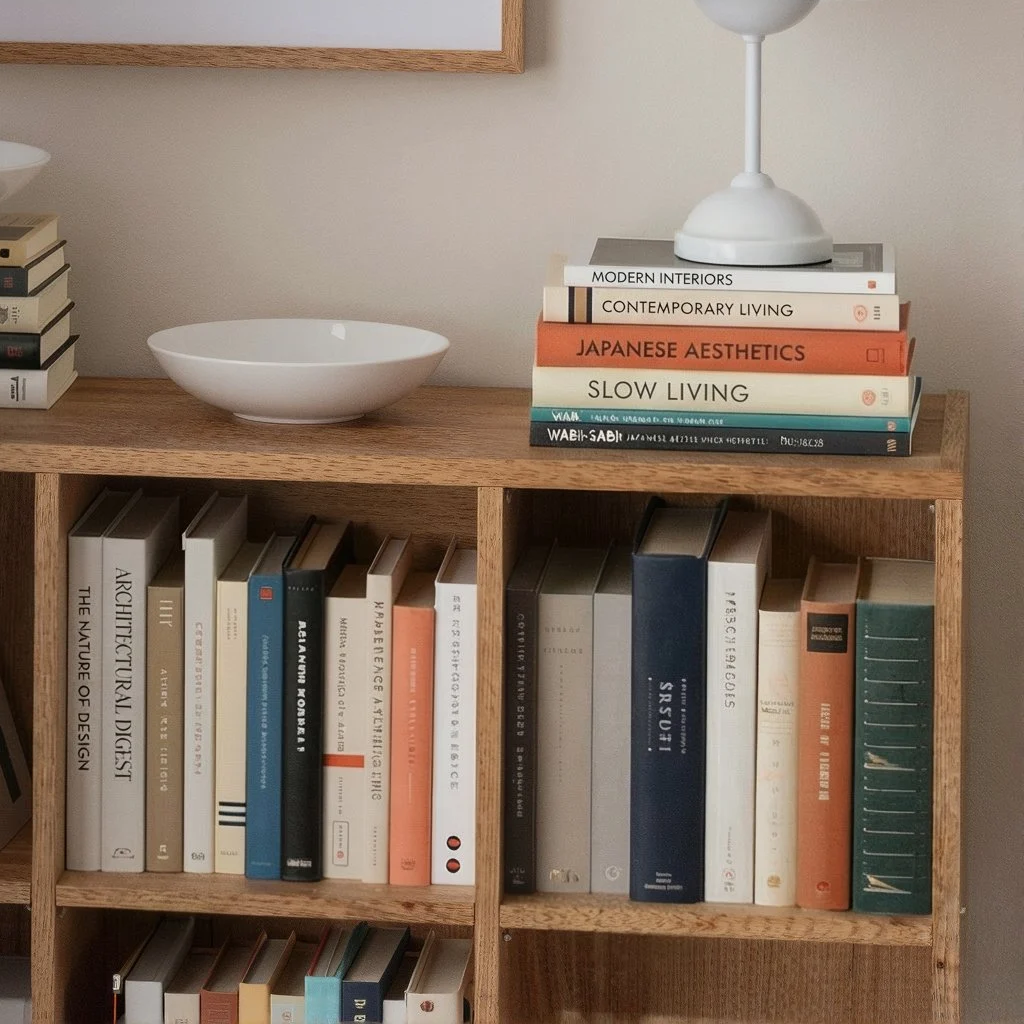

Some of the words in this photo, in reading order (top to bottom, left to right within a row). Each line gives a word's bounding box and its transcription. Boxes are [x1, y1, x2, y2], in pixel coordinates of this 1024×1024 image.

[591, 271, 655, 284] MODERN
[659, 272, 733, 286] INTERIORS
[602, 299, 734, 316] CONTEMPORARY
[739, 303, 794, 317] LIVING
[576, 339, 678, 359] JAPANESE
[684, 341, 806, 362] AESTHETICS
[587, 380, 657, 400] SLOW
[667, 382, 750, 403] LIVING
[78, 585, 91, 616] THE
[77, 620, 91, 681] NATURE
[114, 567, 133, 720] ARCHITECTURAL
[77, 684, 91, 708] OF
[77, 712, 91, 772] DESIGN
[114, 722, 133, 782] DIGEST
